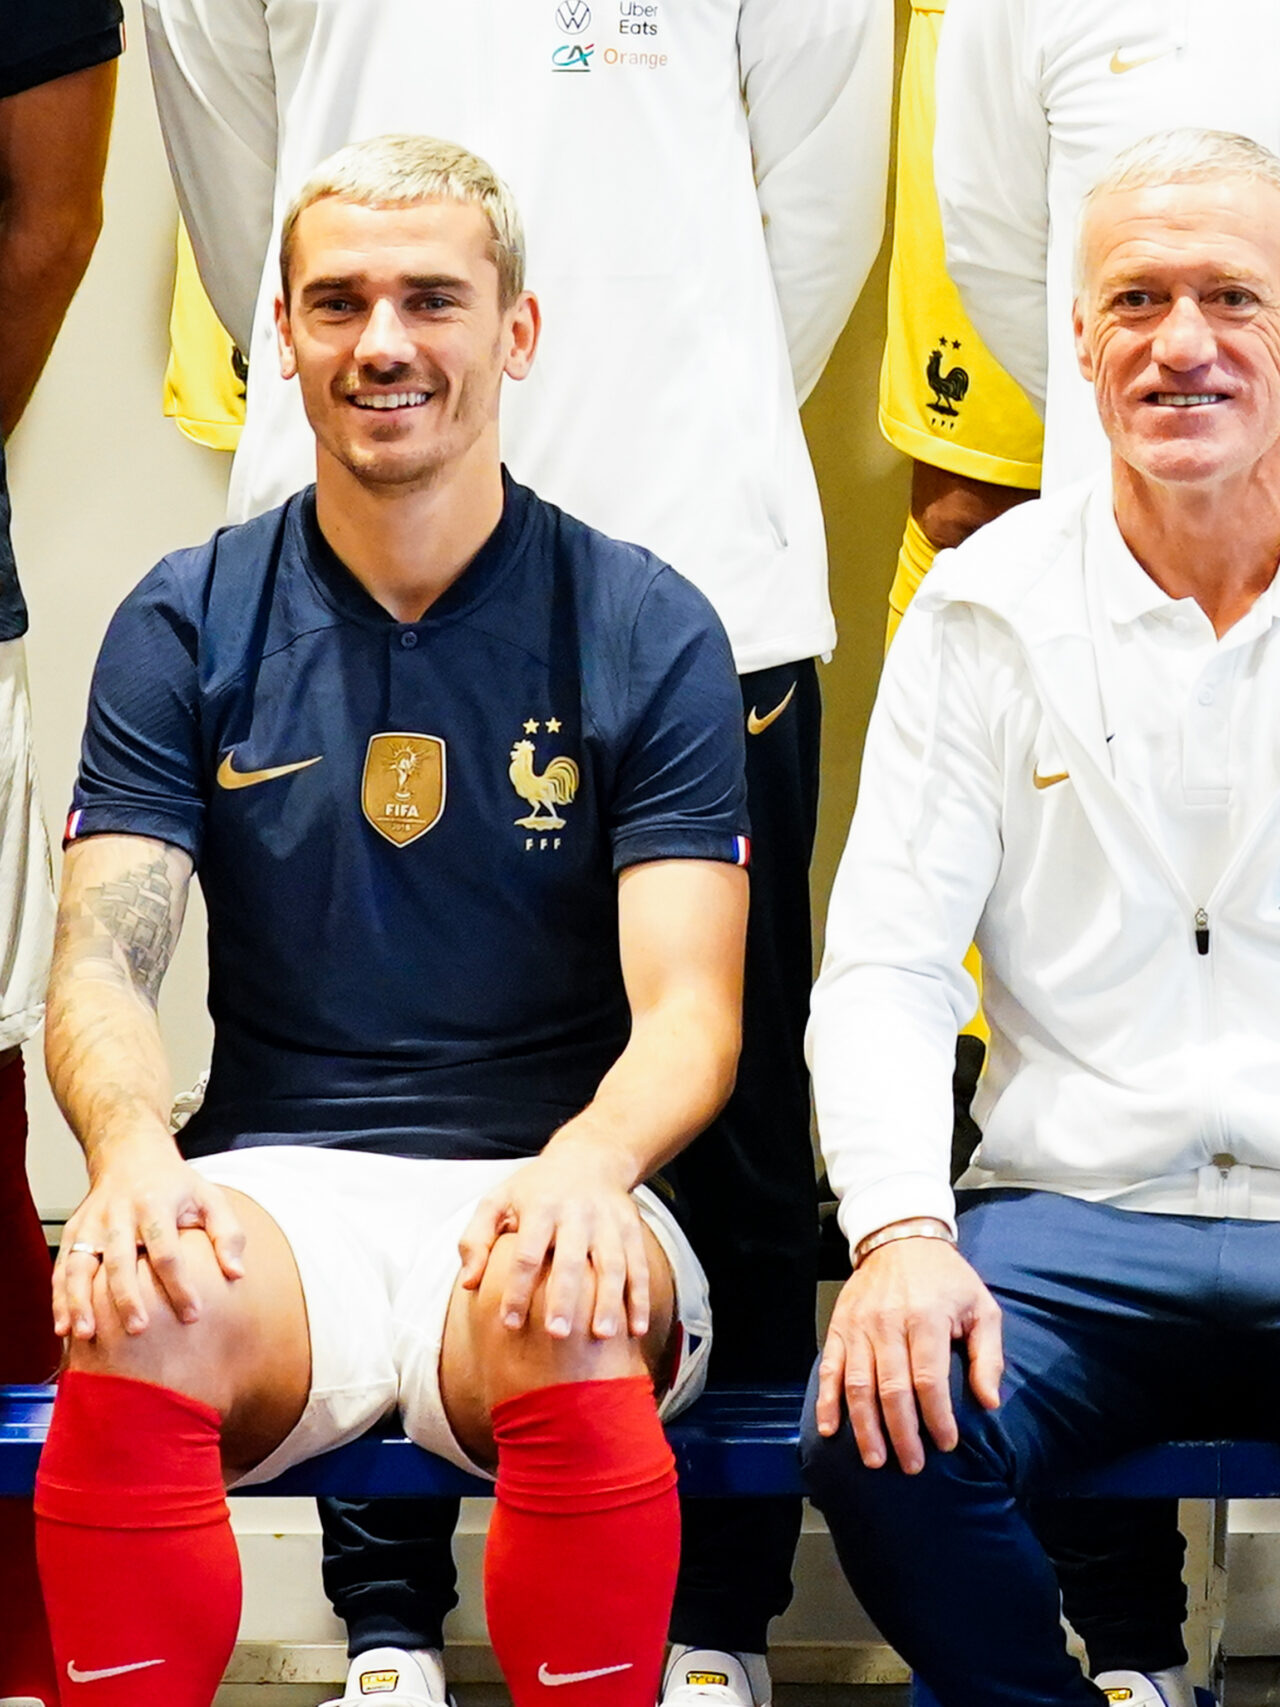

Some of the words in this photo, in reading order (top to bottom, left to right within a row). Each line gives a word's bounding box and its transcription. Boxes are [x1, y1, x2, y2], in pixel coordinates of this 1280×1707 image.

[619, 0, 659, 17] Uber
[619, 19, 658, 36] Eats
[603, 48, 668, 69] Orange
[384, 803, 420, 818] FIFA
